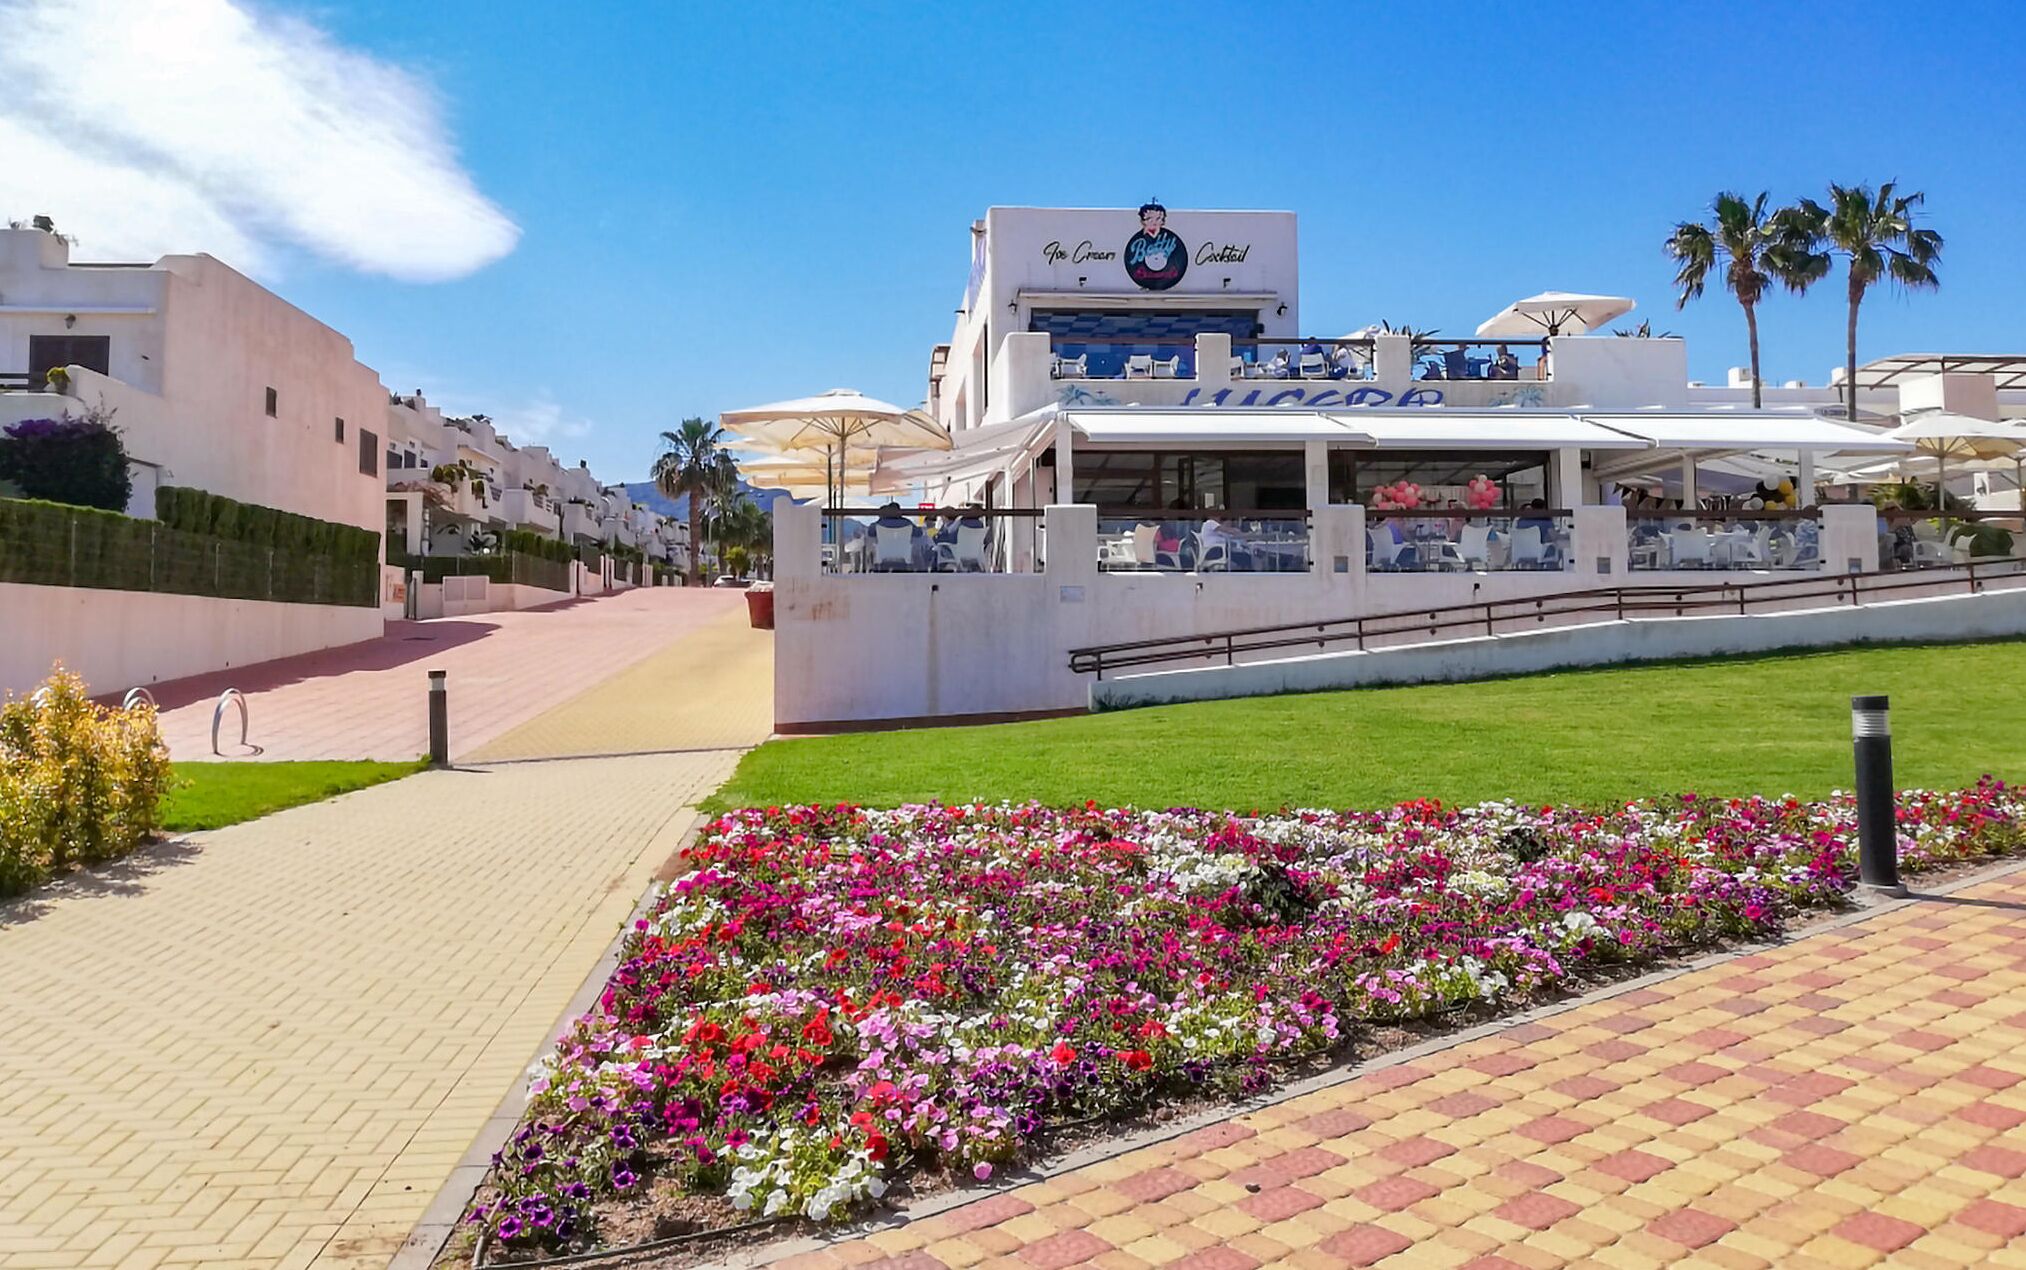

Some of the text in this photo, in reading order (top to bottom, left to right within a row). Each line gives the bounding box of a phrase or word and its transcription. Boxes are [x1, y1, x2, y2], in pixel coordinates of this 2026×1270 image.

[1043, 240, 1116, 265] Ice Cream
[1130, 232, 1177, 265] Betty
[1195, 242, 1251, 265] Cocktail
